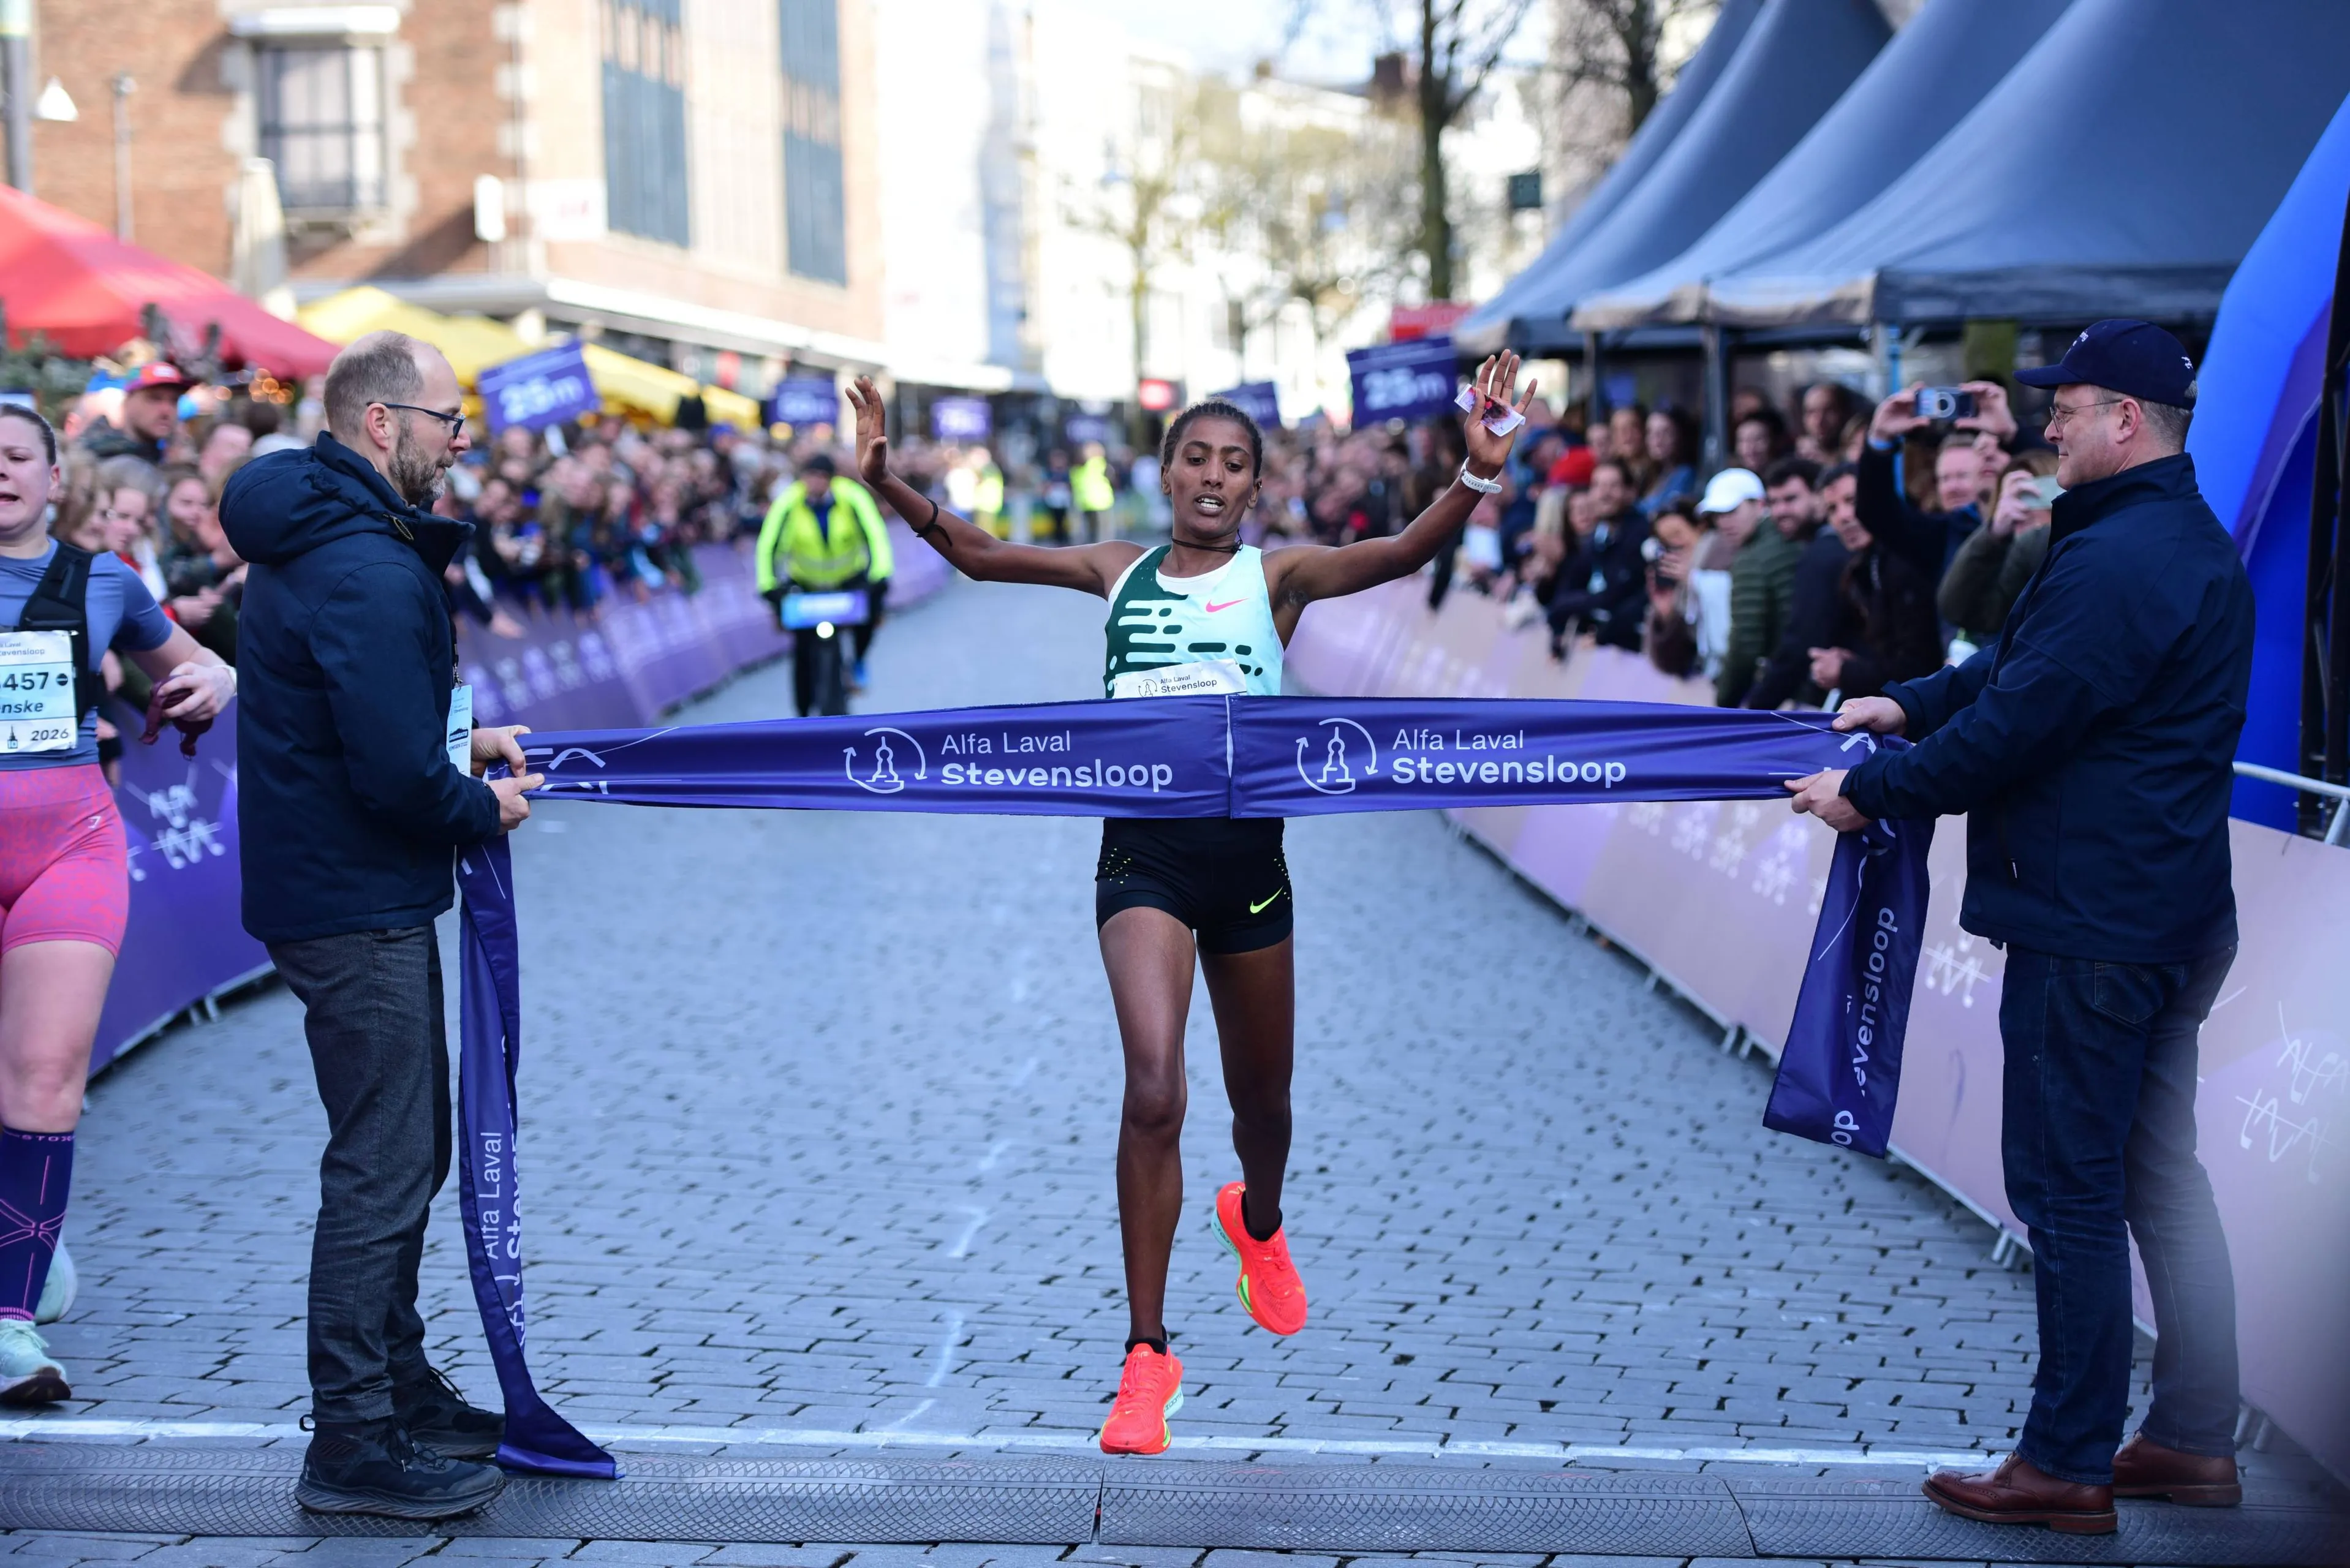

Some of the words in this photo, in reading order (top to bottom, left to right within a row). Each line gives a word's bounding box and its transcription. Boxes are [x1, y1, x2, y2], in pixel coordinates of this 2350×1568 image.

[0, 672, 49, 691] 457
[1161, 679, 1217, 693] Stevensloop
[31, 728, 69, 742] 2026
[941, 734, 992, 755] Alfa
[1003, 731, 1070, 753] Laval
[1392, 728, 1444, 750] Alfa
[1456, 729, 1524, 750] Laval
[941, 759, 1173, 793] Stevensloop
[1392, 755, 1626, 788] Stevensloop
[1853, 907, 1898, 1097] evensloop
[478, 1132, 502, 1198] Laval
[480, 1209, 499, 1260] Alfa
